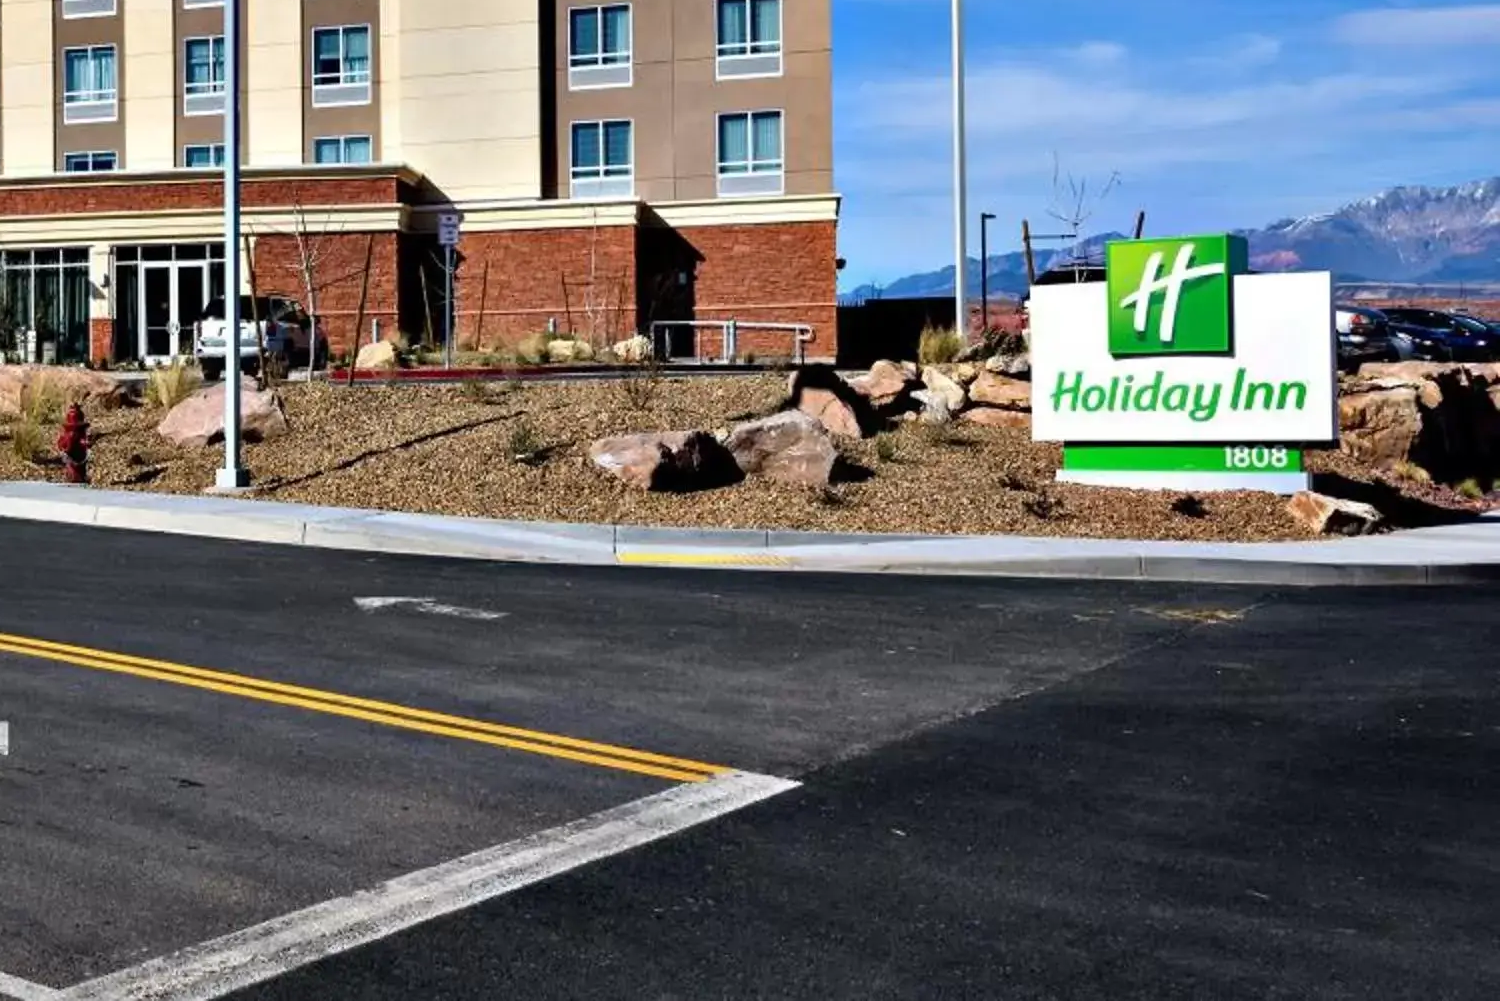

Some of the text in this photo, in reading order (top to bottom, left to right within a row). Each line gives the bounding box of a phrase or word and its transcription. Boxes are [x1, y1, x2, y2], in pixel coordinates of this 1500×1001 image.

[1050, 368, 1307, 422] Holiday Inn
[1223, 445, 1288, 468] 1808
